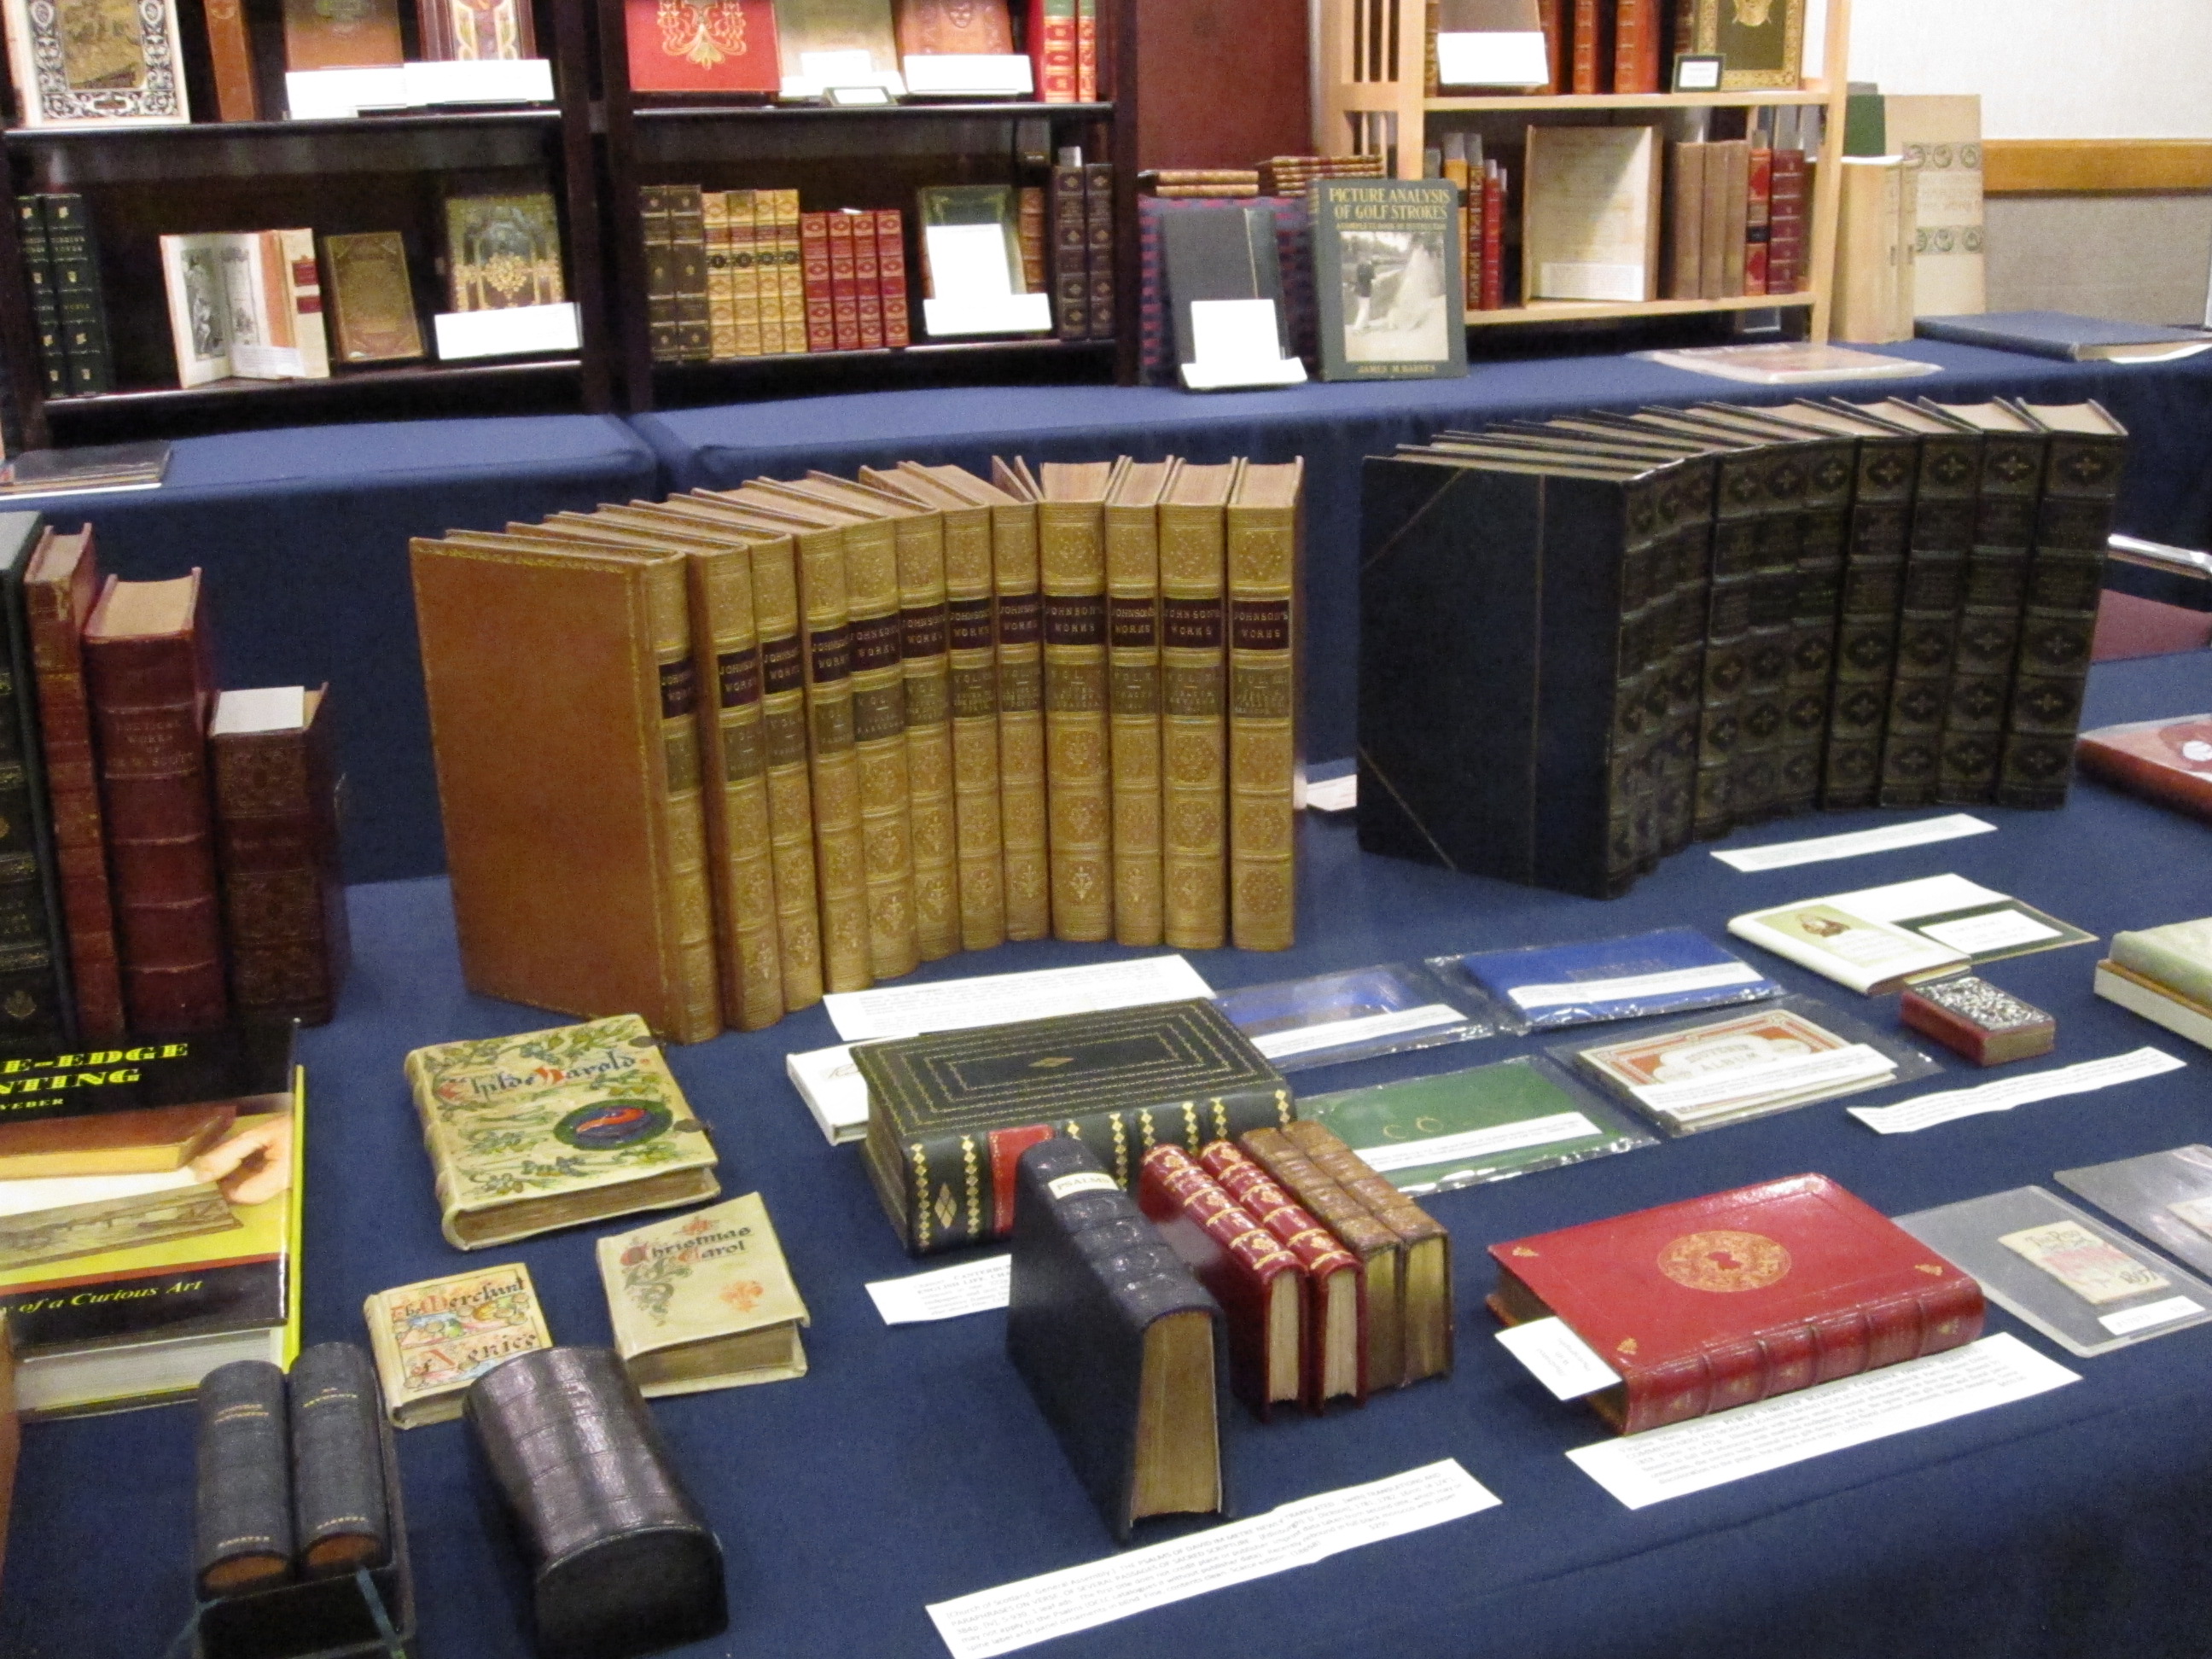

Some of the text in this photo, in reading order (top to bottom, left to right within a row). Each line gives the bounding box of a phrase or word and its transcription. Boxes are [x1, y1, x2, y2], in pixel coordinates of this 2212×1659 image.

[1330, 188, 1451, 203] PICTURE ANALYSIS
[1334, 205, 1448, 220] OF GOLF STROKES
[953, 626, 989, 637] WORKS
[1004, 620, 1038, 631] WORKS
[1055, 623, 1096, 632] WORKS
[1115, 625, 1151, 634] WORKS
[1172, 626, 1213, 636] WORKS
[907, 632, 943, 644] WORKS
[1242, 628, 1281, 638] WORKS
[859, 644, 896, 657] WORKS
[433, 1050, 637, 1103] Childe Harold
[1057, 1178, 1110, 1190] PSALMS
[677, 1240, 746, 1264] Carol
[19, 1297, 48, 1313] of
[49, 1300, 64, 1309] a
[71, 1287, 160, 1307] Curious
[166, 1280, 204, 1295] Art
[420, 1277, 524, 1314] Merchant
[428, 1334, 537, 1368] Venice
